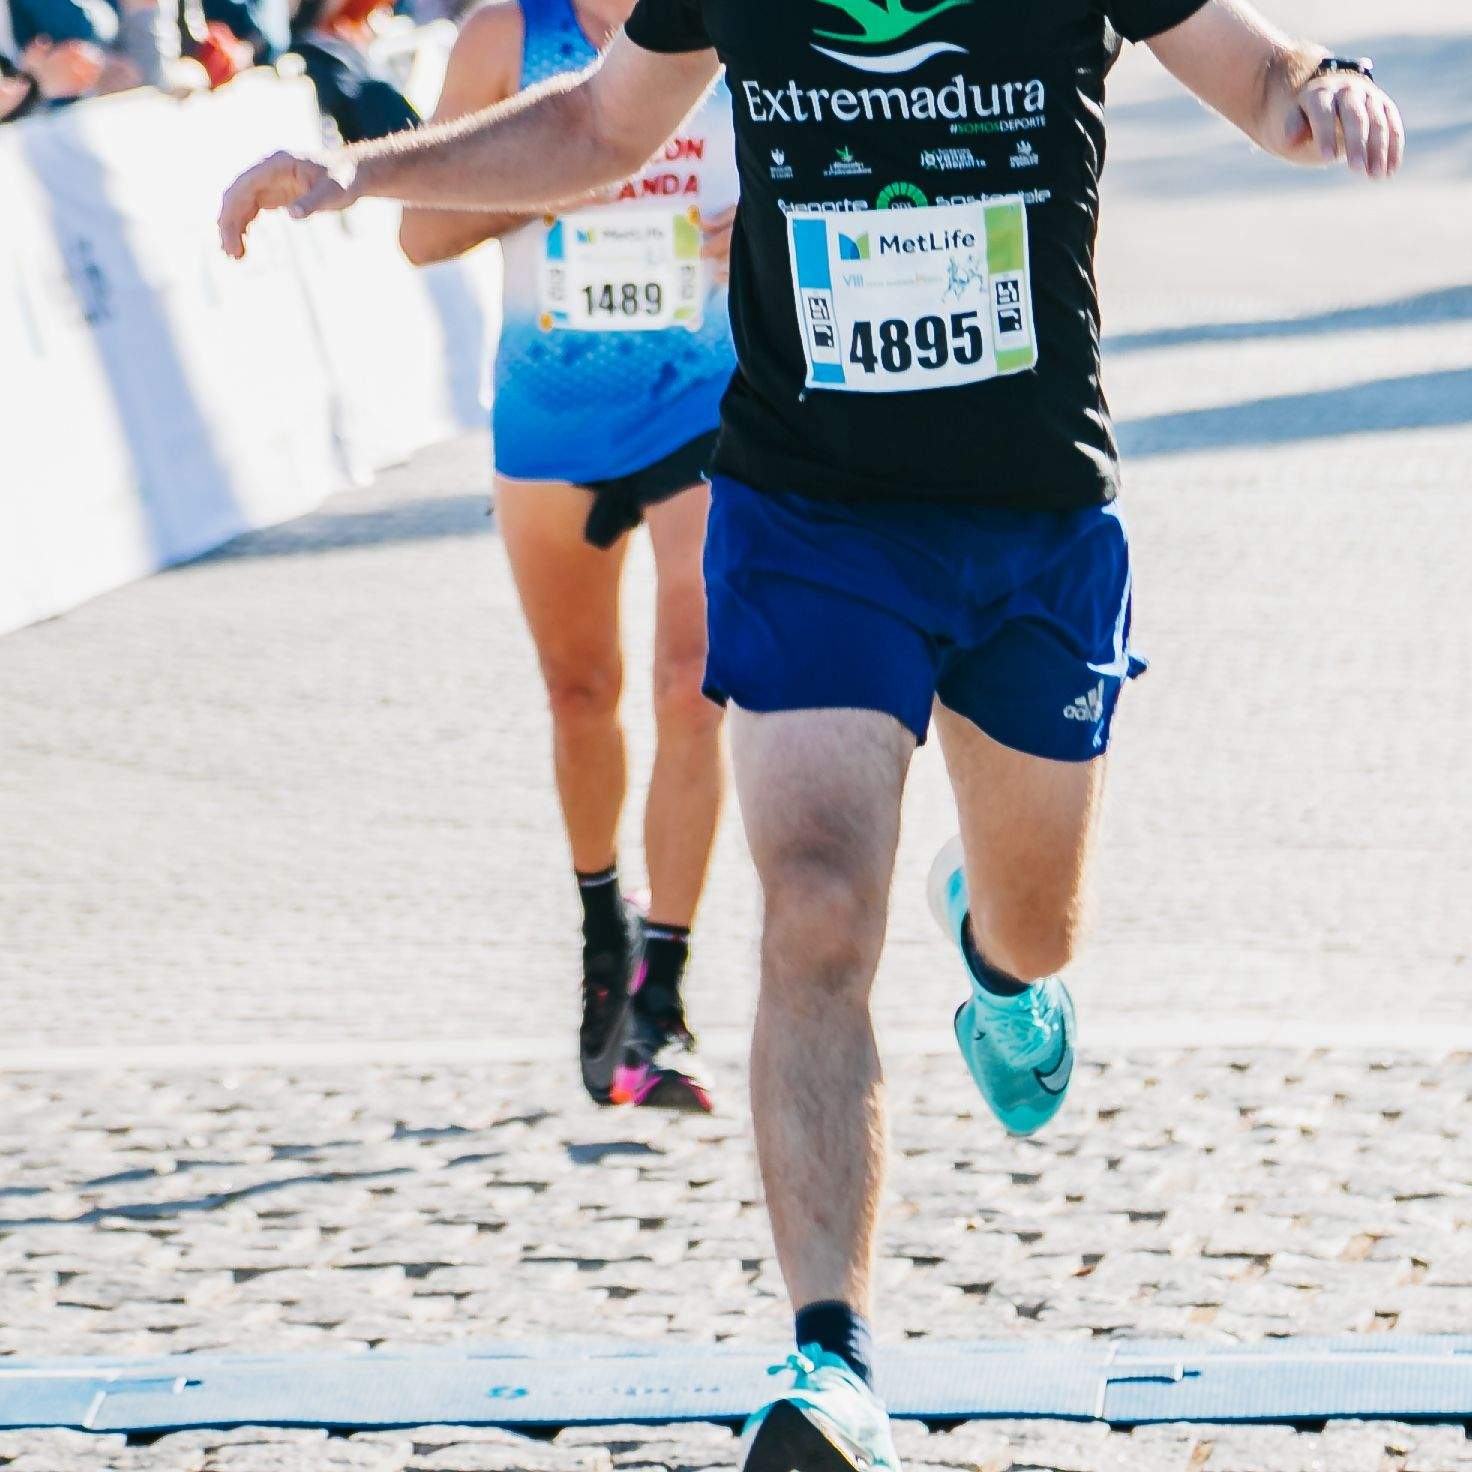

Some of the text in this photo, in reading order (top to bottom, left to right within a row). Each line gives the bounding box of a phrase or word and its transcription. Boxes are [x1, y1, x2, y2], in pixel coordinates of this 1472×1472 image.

[742, 74, 1046, 122] Extremadura
[879, 229, 976, 255] MetLife
[582, 282, 663, 316] 1489
[849, 310, 984, 374] 4895
